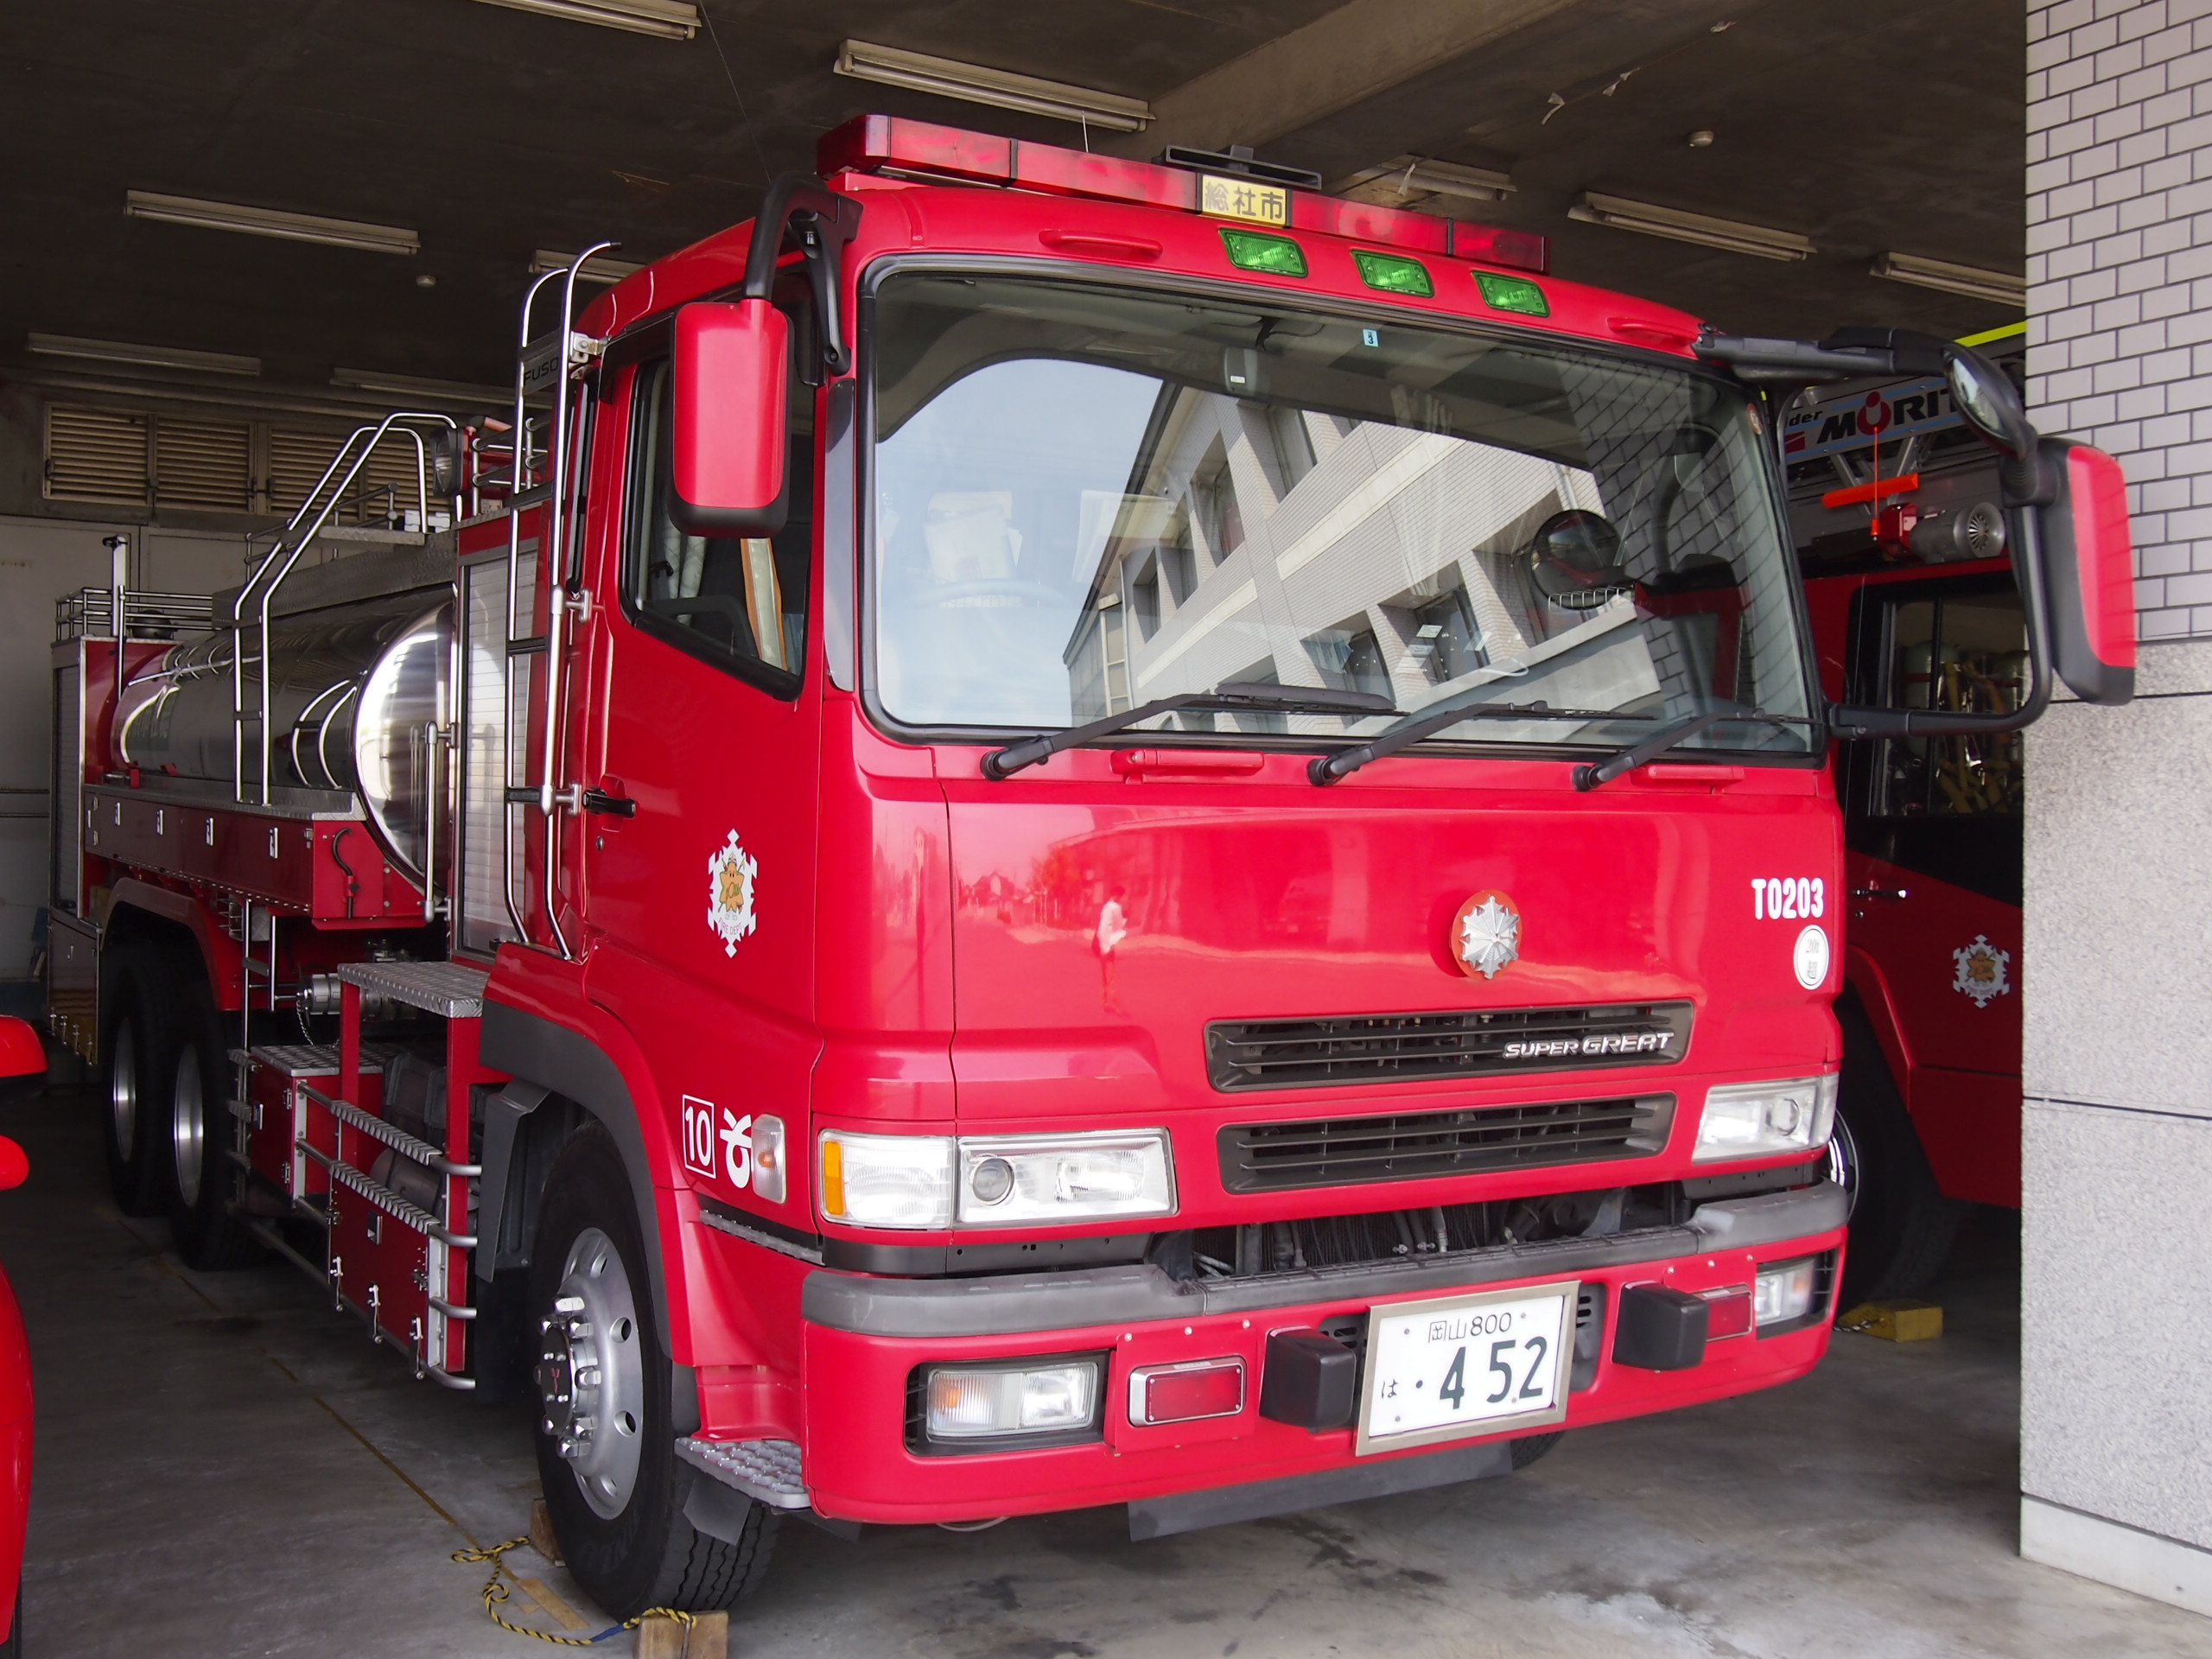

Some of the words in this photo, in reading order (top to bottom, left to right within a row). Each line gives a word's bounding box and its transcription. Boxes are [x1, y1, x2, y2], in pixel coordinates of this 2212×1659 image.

[1205, 181, 1283, 220] 総社市
[524, 356, 559, 386] FUSO
[1784, 410, 1823, 428] der
[1751, 877, 1824, 920] T0203
[1504, 1041, 1580, 1058] SUPER
[1582, 1032, 1675, 1055] GREAT
[685, 1105, 712, 1166] 10
[1381, 1379, 1399, 1400] は
